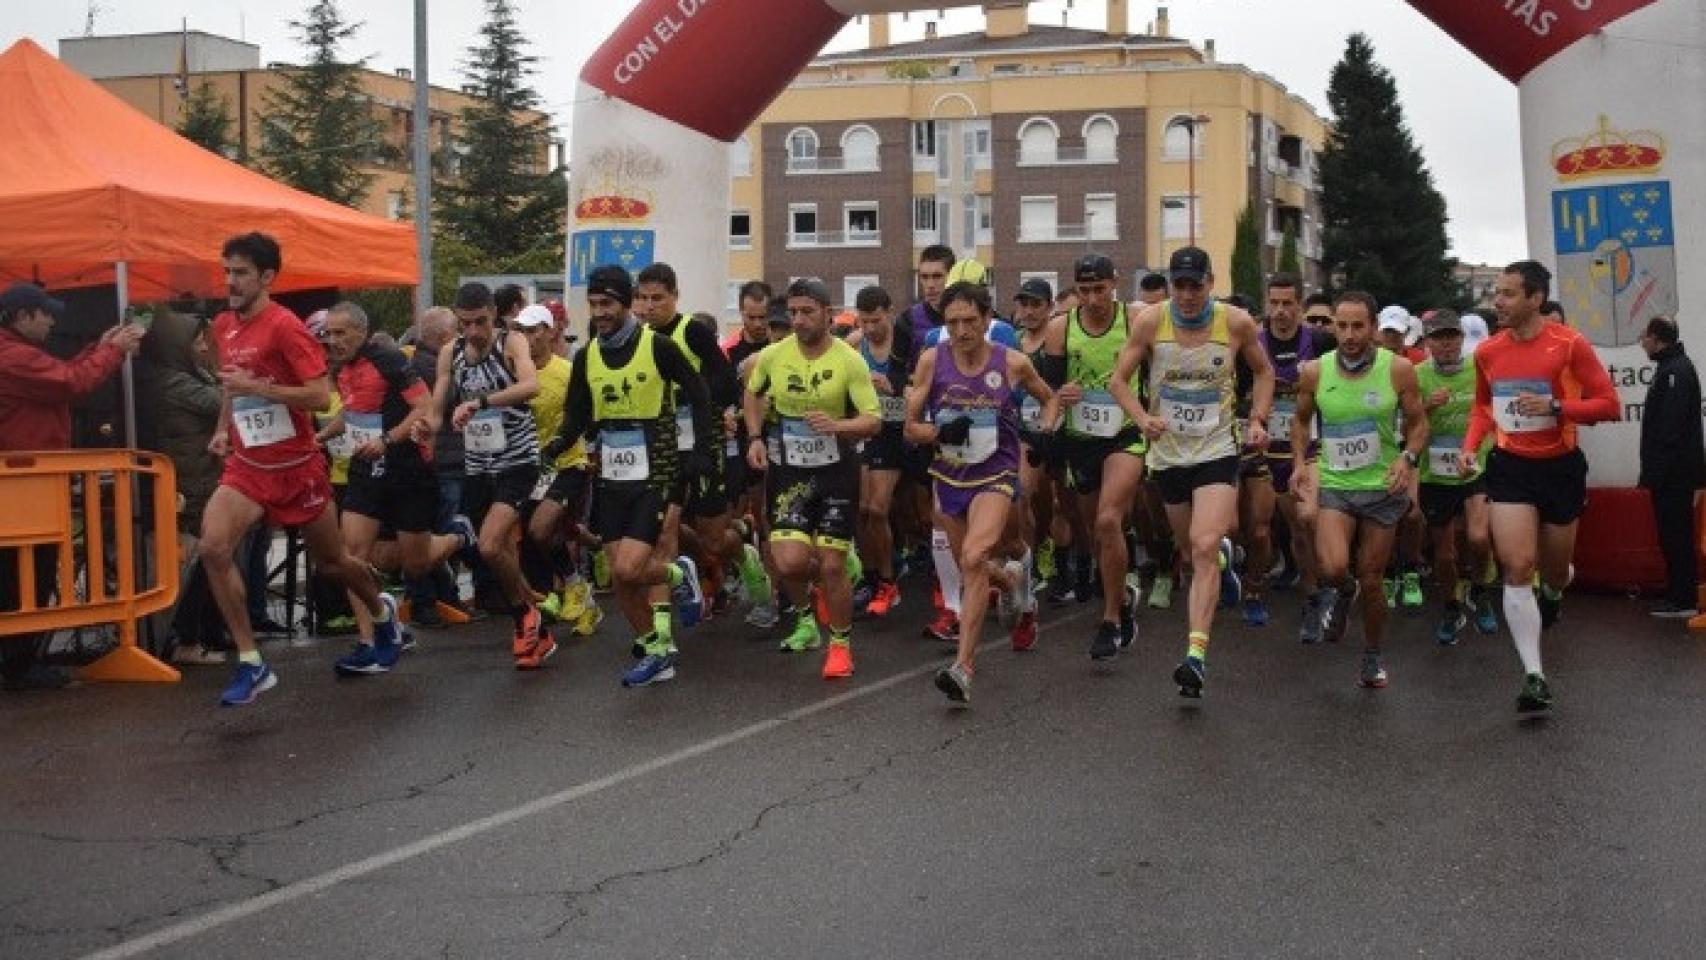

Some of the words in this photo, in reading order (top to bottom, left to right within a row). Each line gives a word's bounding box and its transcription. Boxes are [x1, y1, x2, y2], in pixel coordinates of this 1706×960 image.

[614, 36, 660, 83] CON
[653, 16, 684, 42] EL
[1172, 405, 1206, 422] 207
[1335, 438, 1369, 457] 700
